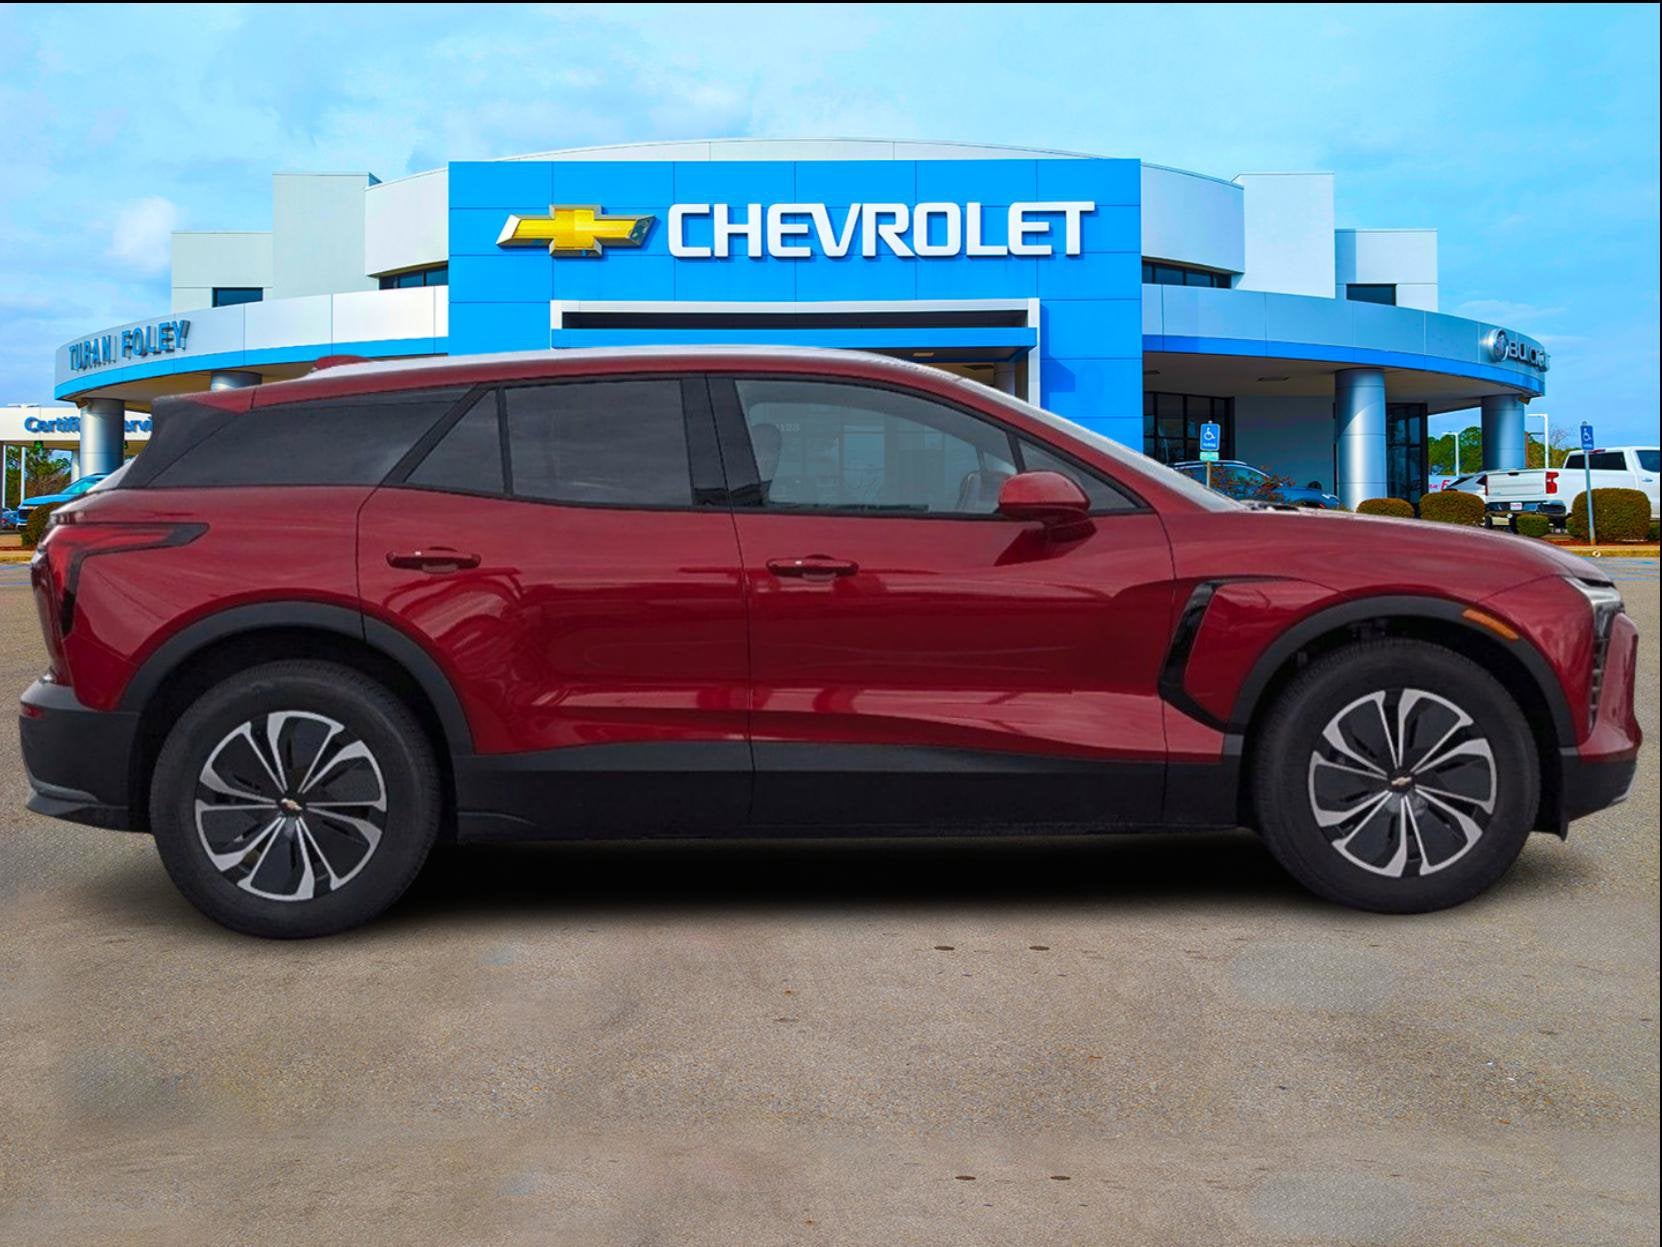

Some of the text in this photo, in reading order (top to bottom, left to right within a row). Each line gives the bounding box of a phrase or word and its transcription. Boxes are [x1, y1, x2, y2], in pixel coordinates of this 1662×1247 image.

[667, 200, 1096, 258] CHEVROLET
[69, 319, 190, 371] TURAN FOLEY
[24, 415, 80, 433] Certifi
